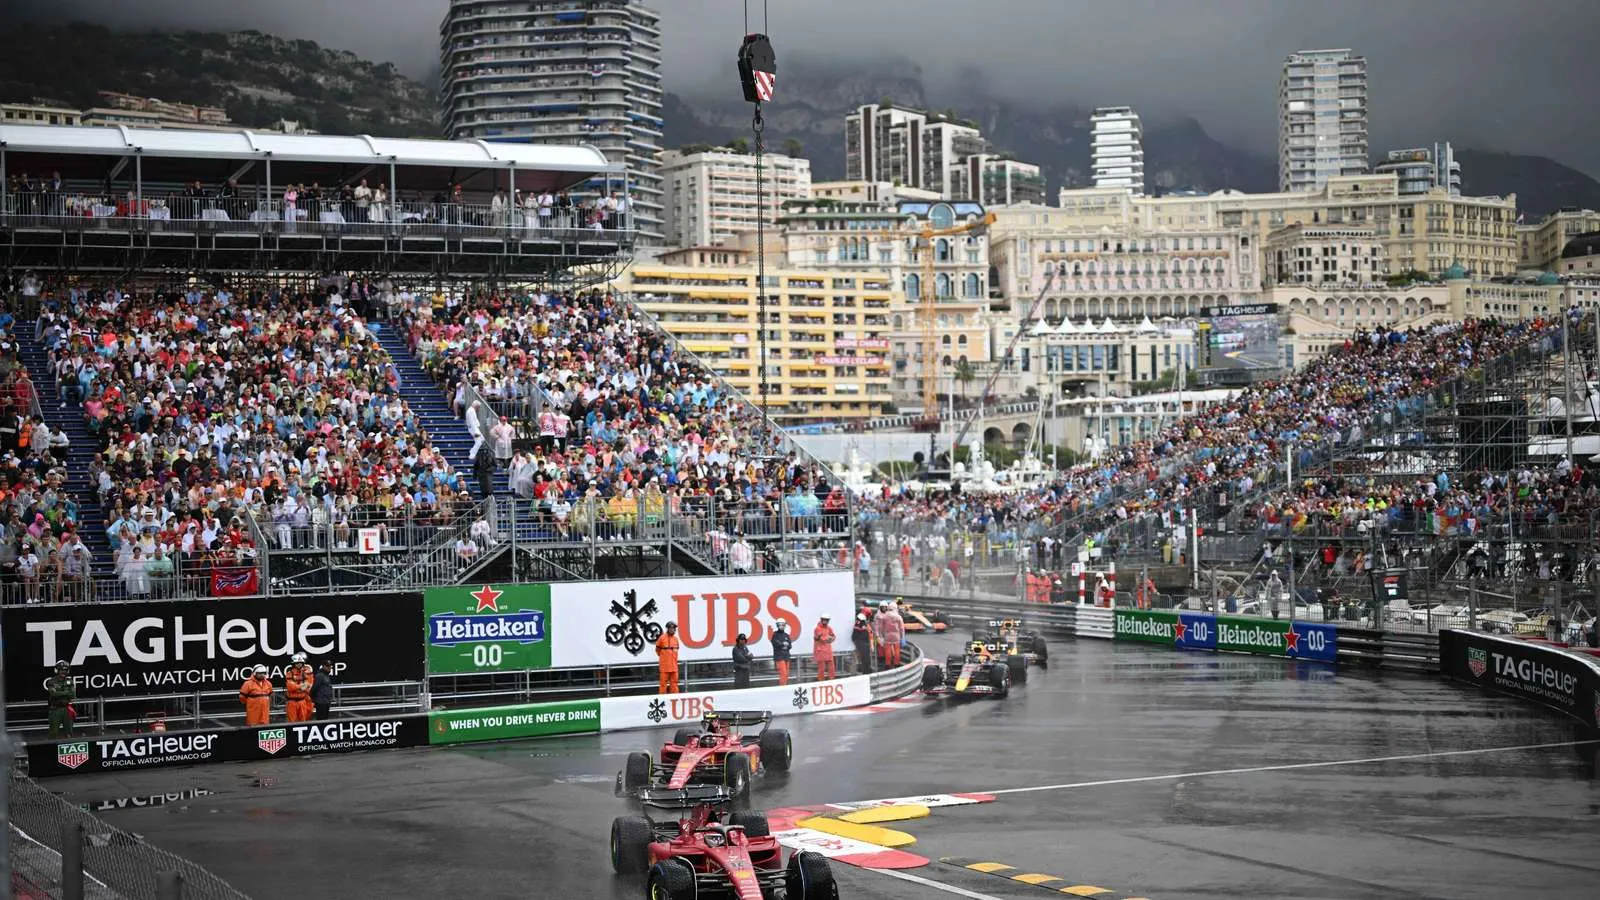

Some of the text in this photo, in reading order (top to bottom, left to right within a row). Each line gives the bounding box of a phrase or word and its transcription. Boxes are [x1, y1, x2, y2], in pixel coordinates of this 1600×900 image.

[1222, 306, 1268, 315] TAGHeuer
[365, 538, 374, 550] L
[435, 618, 538, 639] Heineken
[672, 589, 803, 649] UBS
[1117, 615, 1172, 637] Heineken
[1218, 624, 1282, 647] Heineken
[43, 672, 137, 692] FICIAL
[143, 669, 216, 686] WATCH
[811, 685, 845, 706] UBS
[671, 695, 714, 720] UBS
[450, 709, 597, 730] WHEN YOU DRIVE NEVER DRINK
[261, 730, 285, 739] TAG
[293, 721, 402, 743] TAGHeuer
[61, 743, 86, 753] TAG
[96, 734, 218, 759] TAGHeuer
[260, 740, 286, 752] HEUER
[298, 744, 329, 752] OFFICIAL
[330, 741, 354, 749] WATCH
[355, 739, 385, 747] MONACO
[60, 753, 88, 767] HEUER
[102, 759, 136, 768] OFFICIAL
[138, 756, 164, 765] WATCH
[165, 753, 199, 763] MONACO
